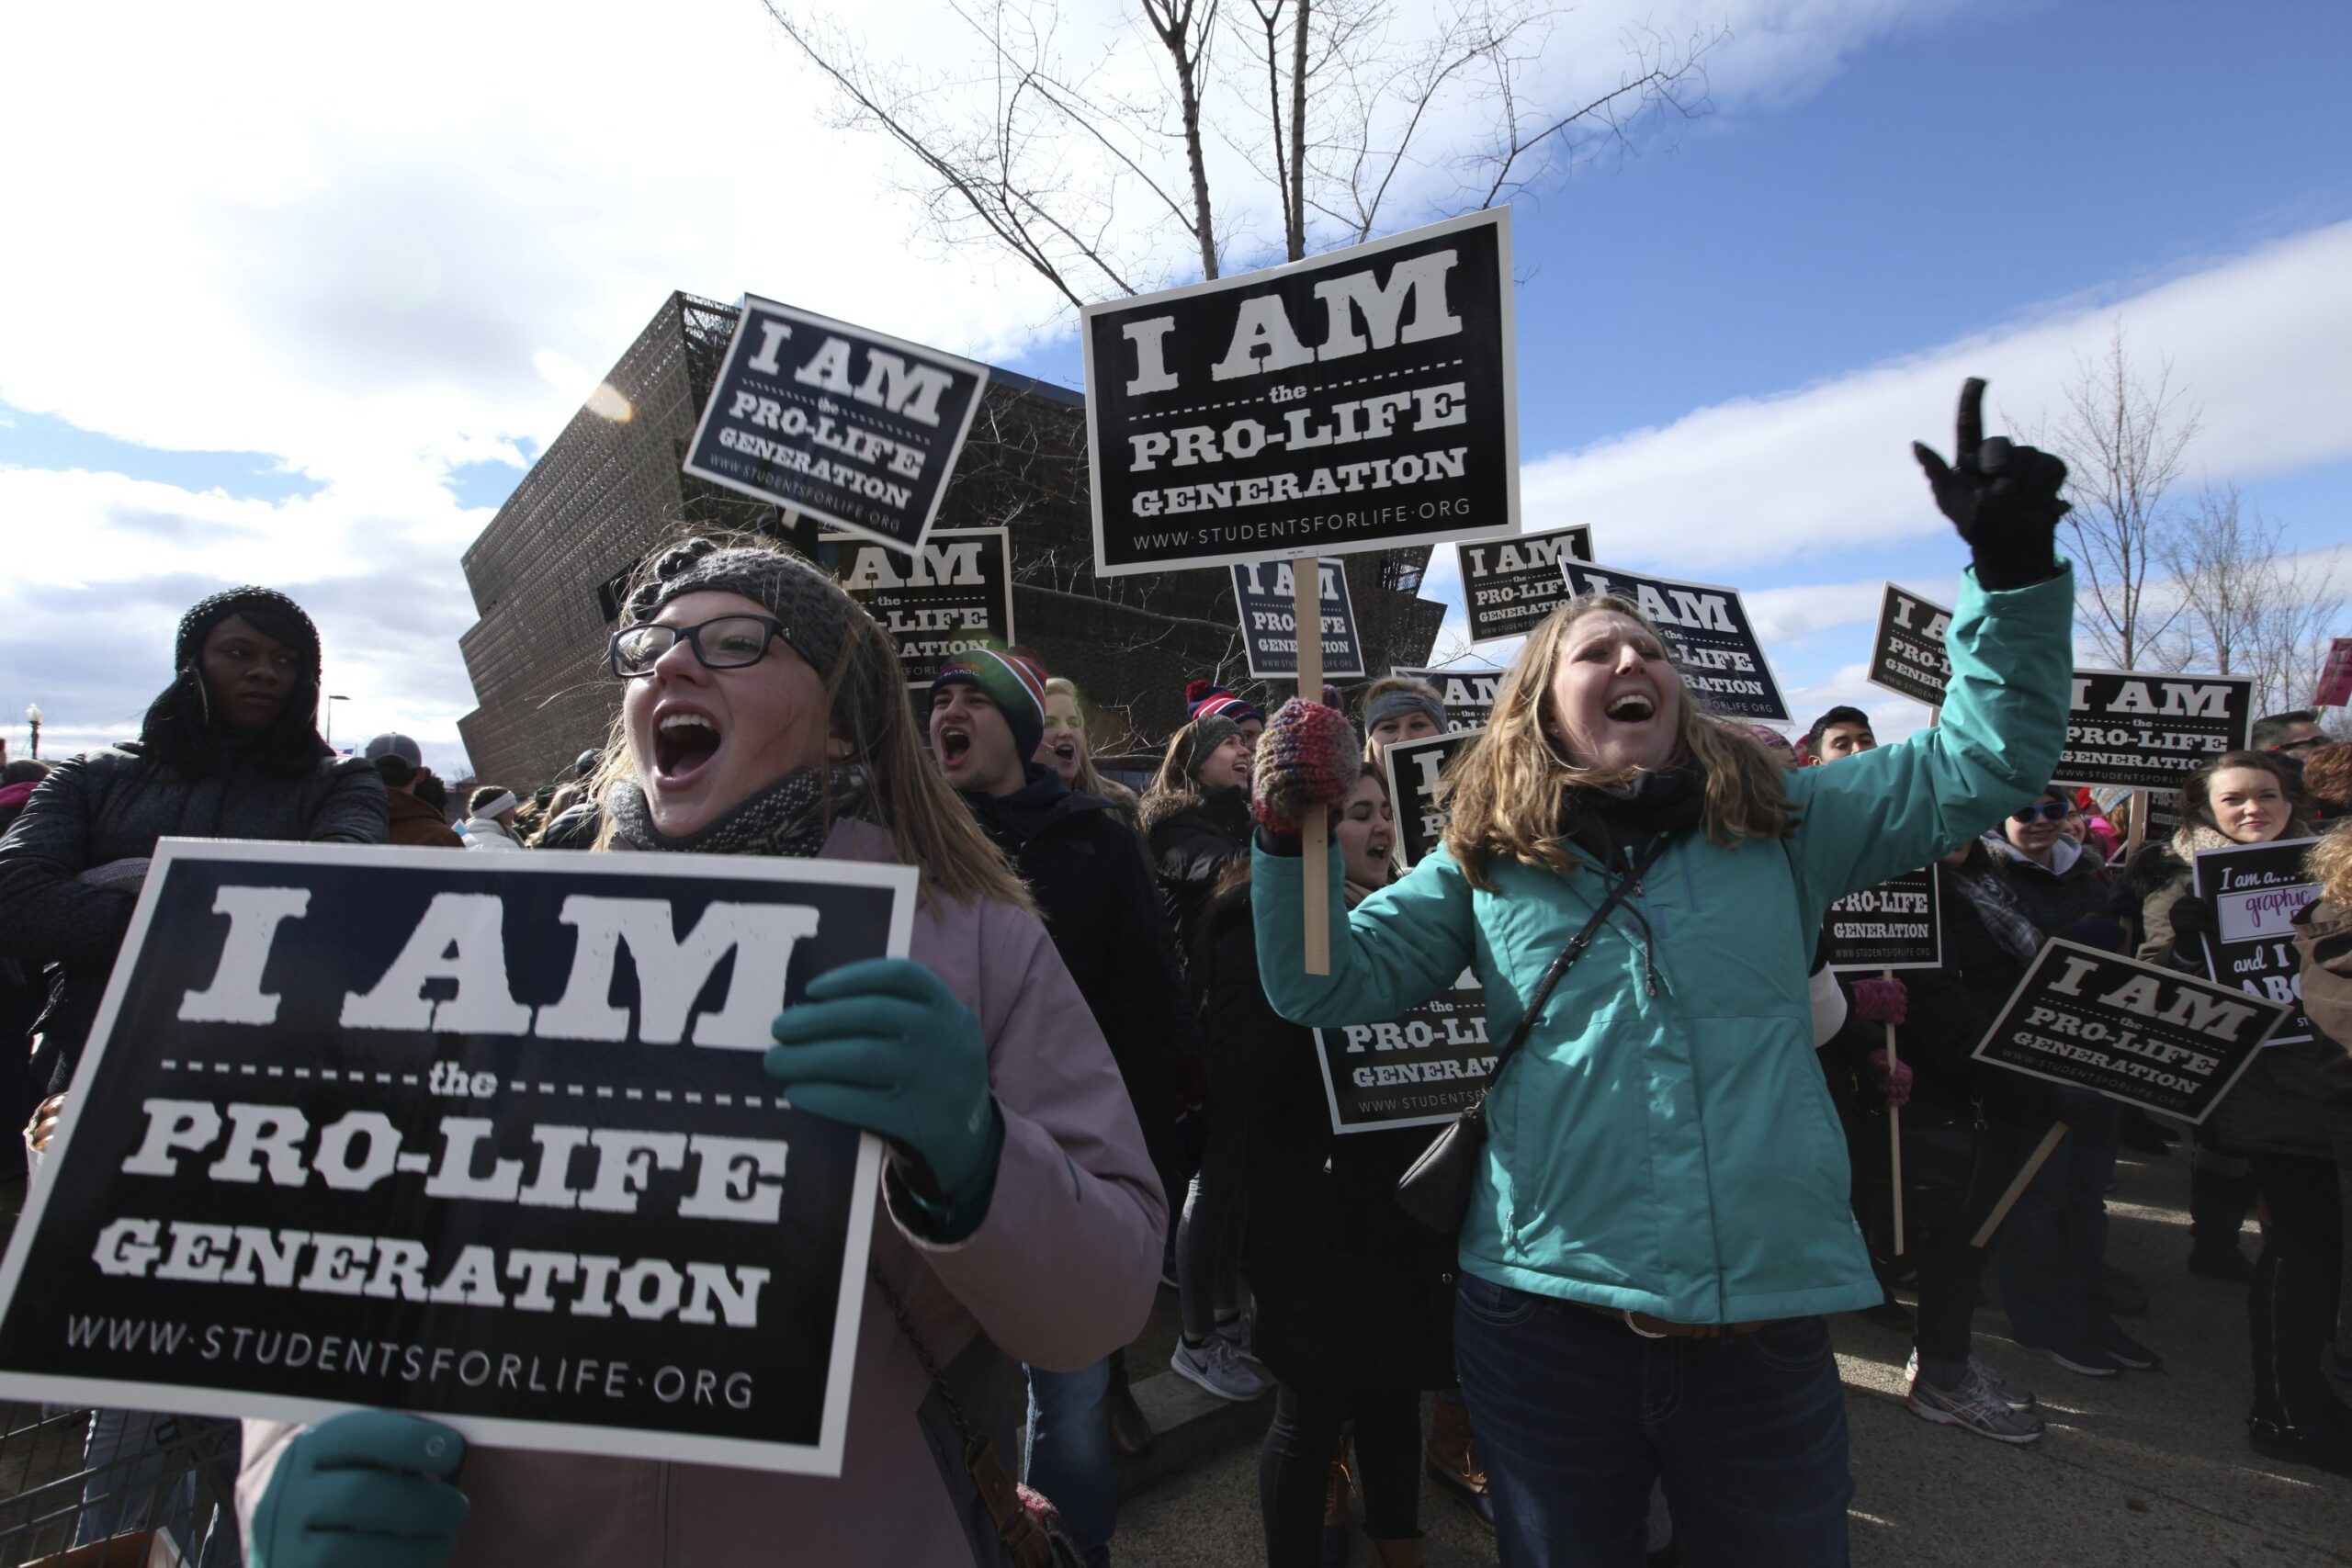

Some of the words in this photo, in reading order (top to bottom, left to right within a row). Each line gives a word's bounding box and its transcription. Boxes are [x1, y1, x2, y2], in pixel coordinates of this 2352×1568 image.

[1123, 315, 1179, 397] I
[1211, 249, 1463, 382] AM
[749, 320, 792, 375] I
[795, 336, 953, 427] AM
[818, 396, 840, 414] the
[1269, 383, 1308, 404] the
[729, 390, 926, 480] PRO-LIFE
[1128, 381, 1467, 472] PRO-LIFE
[719, 426, 911, 510] GENERATION
[1131, 446, 1468, 518] GENERATION
[842, 543, 985, 590] AM
[1469, 548, 1487, 578] I
[1496, 535, 1577, 573] AM
[1243, 562, 1265, 595] I
[1475, 579, 1568, 605] PRO-LIF
[1512, 575, 1527, 583] the
[877, 596, 901, 606] the
[1479, 599, 1569, 623] GENERATIO
[1636, 584, 1738, 633] AM
[876, 607, 989, 633] -LIFE
[1665, 629, 1684, 640] the
[1894, 596, 1916, 629] I
[1921, 613, 1953, 643] A
[1669, 644, 1756, 672] -LIFE
[1888, 637, 1954, 676] PRO-L
[1462, 710, 1476, 718] the
[2071, 679, 2092, 711] I
[2106, 681, 2233, 718] AM
[2065, 726, 2228, 752] PRO-LIFE
[2132, 718, 2153, 728] the
[2060, 750, 2202, 770] GENERATIO
[2220, 867, 2233, 891] I
[2234, 874, 2262, 888] am
[2246, 888, 2311, 928] graphic
[1834, 922, 1928, 939] GENERATION
[178, 885, 311, 1025] I
[339, 892, 820, 1051] AM
[2233, 944, 2267, 973] and
[2272, 943, 2290, 967] I
[1430, 1000, 1453, 1012] the
[2048, 955, 2099, 997] I
[2098, 974, 2257, 1043] AM
[1342, 1017, 1489, 1053] PRO-LI
[2025, 1006, 2220, 1077] PRO-LIFE
[2120, 1016, 2144, 1031] the
[429, 1062, 499, 1099] the
[1352, 1056, 1498, 1088] GENERAT
[2012, 1032, 2201, 1095] GENERATION
[122, 1100, 788, 1224] PRO-LIFE
[91, 1217, 770, 1328] GENERATION
